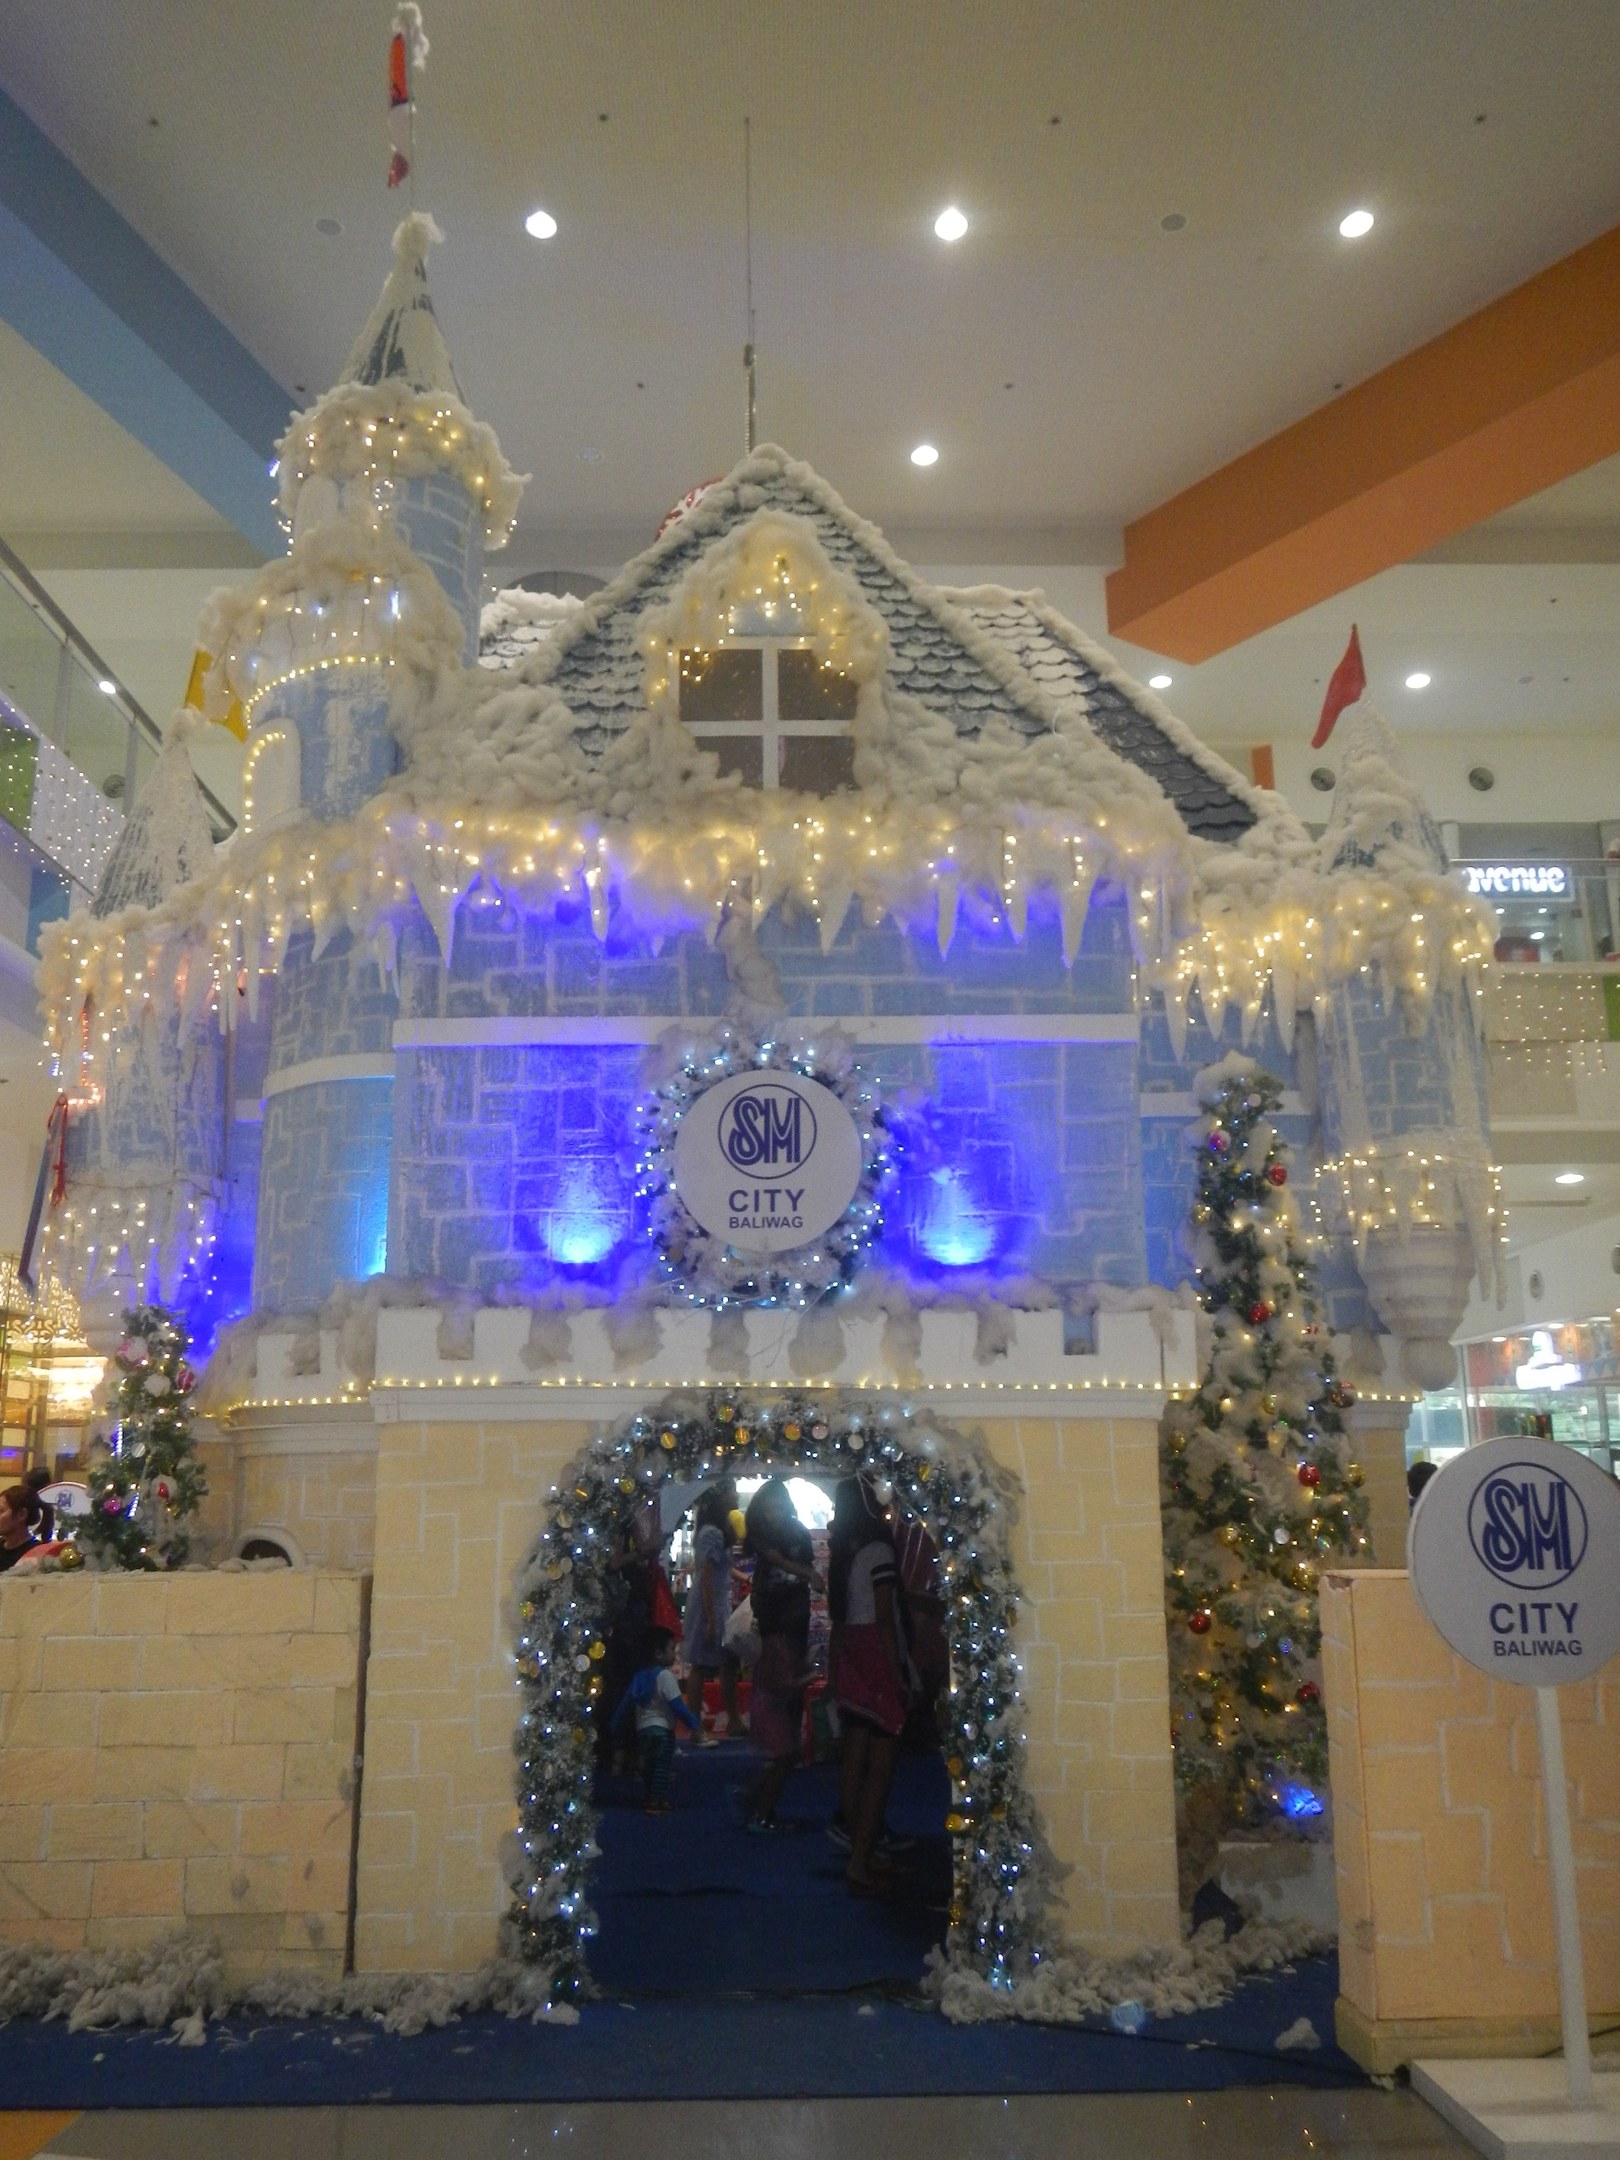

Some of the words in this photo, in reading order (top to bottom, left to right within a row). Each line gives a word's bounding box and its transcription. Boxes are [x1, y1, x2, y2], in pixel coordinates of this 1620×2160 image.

[728, 1095, 801, 1166] SM
[728, 1188, 805, 1213] CITY
[729, 1216, 804, 1229] BALIWAG
[1482, 1478, 1574, 1573] SM
[1489, 1602, 1579, 1635] CITY
[1493, 1639, 1583, 1657] BALIWAG
